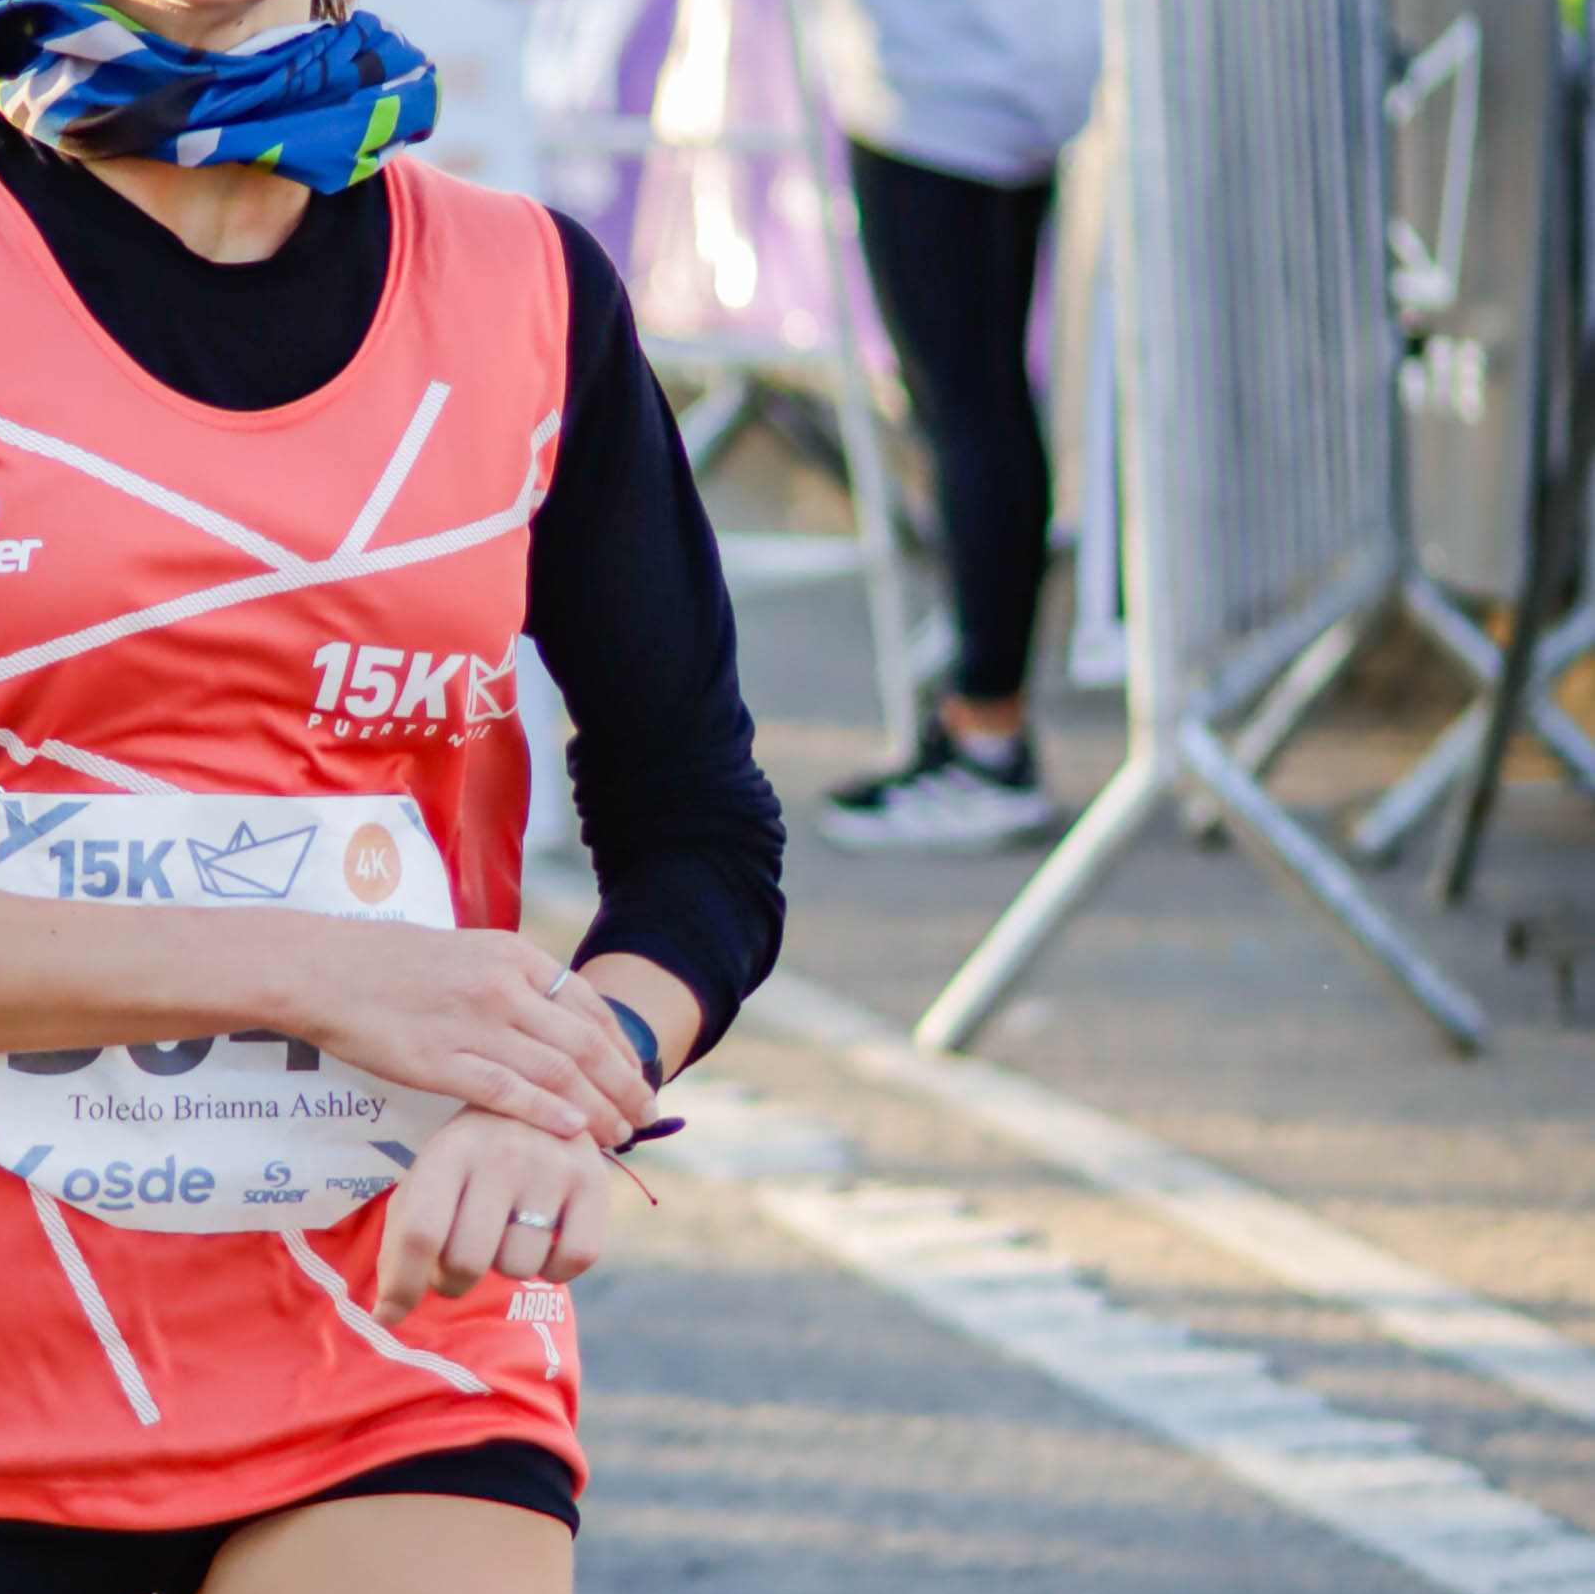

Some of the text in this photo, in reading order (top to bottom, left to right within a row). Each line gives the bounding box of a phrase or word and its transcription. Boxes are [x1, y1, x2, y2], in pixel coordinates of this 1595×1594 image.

[312, 641, 466, 719] 15K
[49, 839, 176, 899] 15K
[355, 847, 390, 881] 4K
[67, 1091, 388, 1123] Toledo Brianna Ashley
[62, 1154, 216, 1210] osde
[505, 1289, 566, 1323] ARDEC
